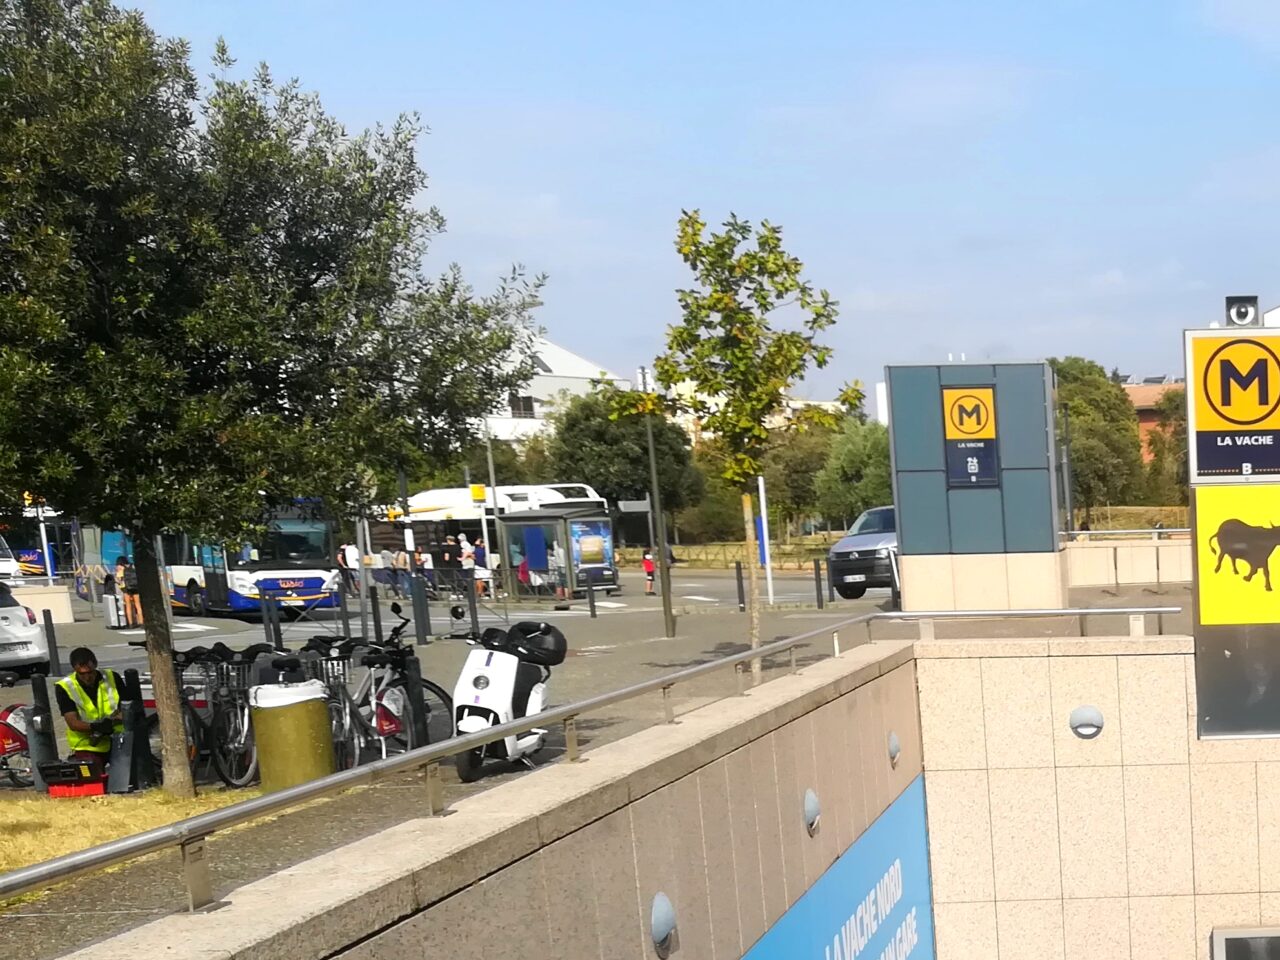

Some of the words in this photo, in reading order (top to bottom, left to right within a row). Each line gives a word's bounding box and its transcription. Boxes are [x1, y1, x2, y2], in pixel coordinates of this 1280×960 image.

[1220, 358, 1269, 406] M
[958, 404, 982, 426] M
[1217, 436, 1232, 446] LA
[1235, 435, 1274, 445] VACHE
[1242, 463, 1252, 474] B
[875, 858, 903, 924] NORD
